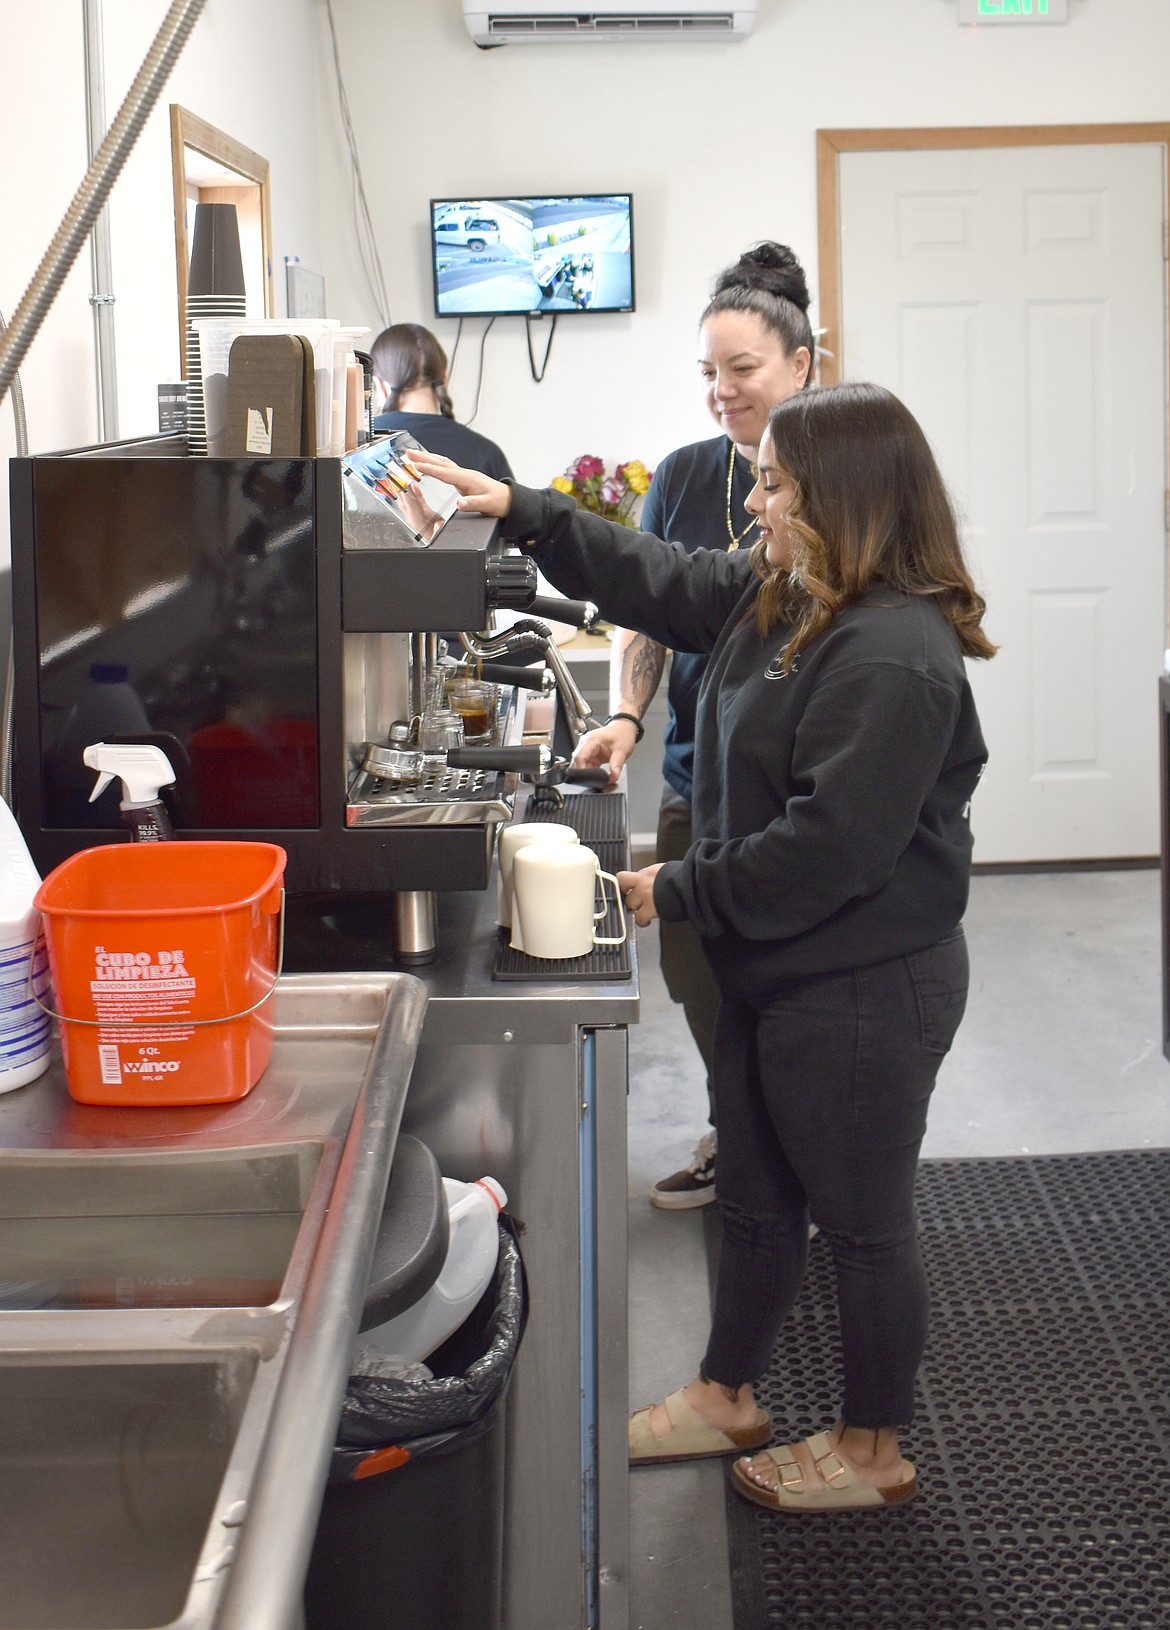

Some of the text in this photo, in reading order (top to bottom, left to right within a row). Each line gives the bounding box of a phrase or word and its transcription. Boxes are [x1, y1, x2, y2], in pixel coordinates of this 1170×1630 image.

[95, 949, 185, 967] CUBO DE
[95, 963, 189, 980] LIMPIEZA
[138, 980, 194, 989] DESINFECTANTE
[138, 1047, 161, 1055] 6 Qt.
